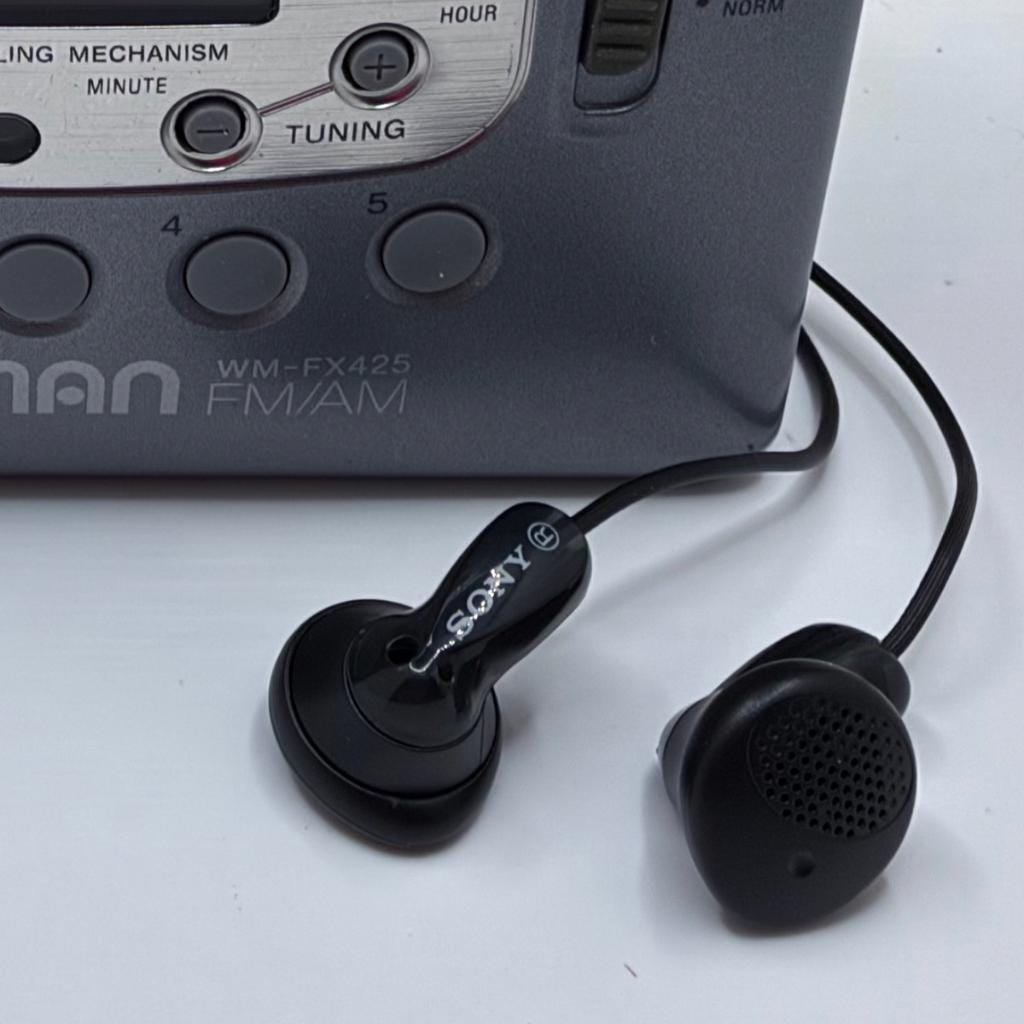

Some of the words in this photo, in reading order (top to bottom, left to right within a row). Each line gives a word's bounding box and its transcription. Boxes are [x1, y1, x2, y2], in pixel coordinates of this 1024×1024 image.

[440, 4, 498, 24] HOUR
[69, 43, 229, 63] MECHANISM
[87, 77, 167, 95] MINUTE
[286, 119, 406, 145] TUNING
[366, 192, 388, 214] 5
[161, 215, 182, 237] 4
[217, 354, 412, 377] WM-FX425
[206, 378, 409, 416] FM/AM
[446, 543, 532, 642] SONY
